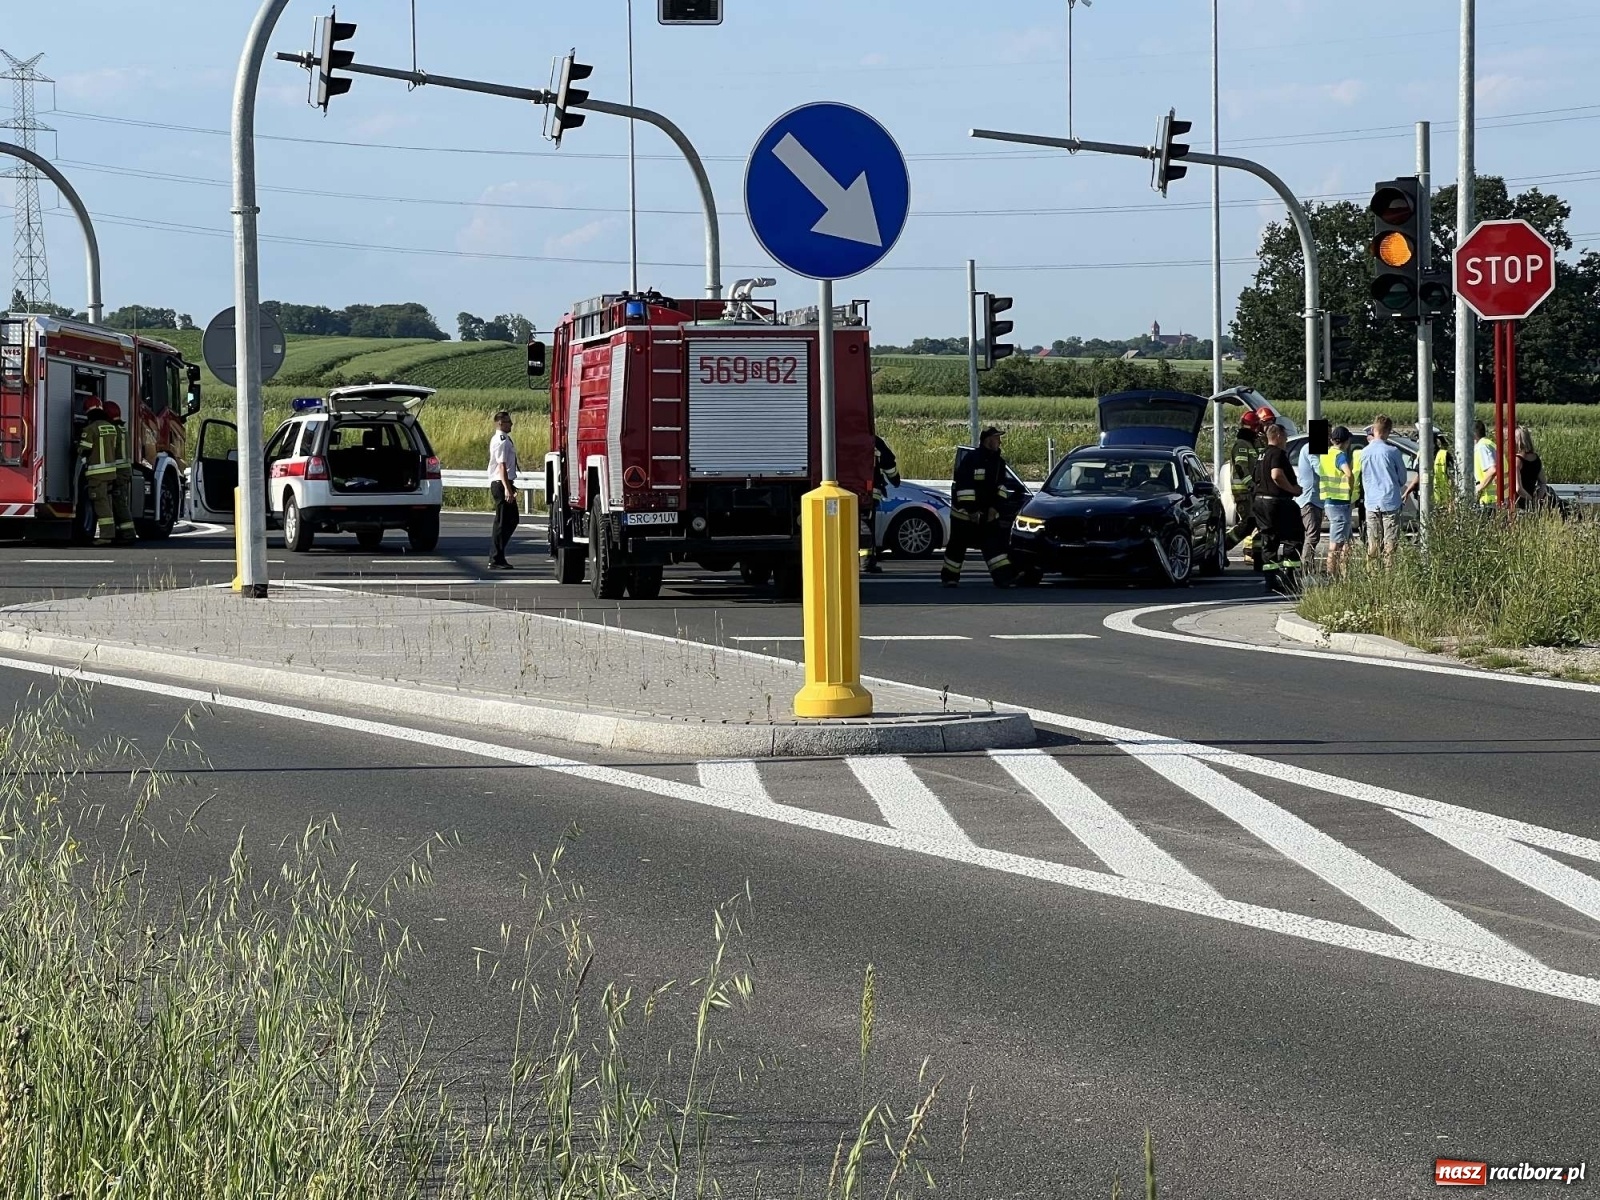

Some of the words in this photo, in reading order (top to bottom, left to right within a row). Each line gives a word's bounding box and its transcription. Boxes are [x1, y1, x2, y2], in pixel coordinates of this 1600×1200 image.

[1466, 254, 1543, 285] STOP
[629, 513, 650, 524] SRC
[652, 512, 676, 523] 91UV
